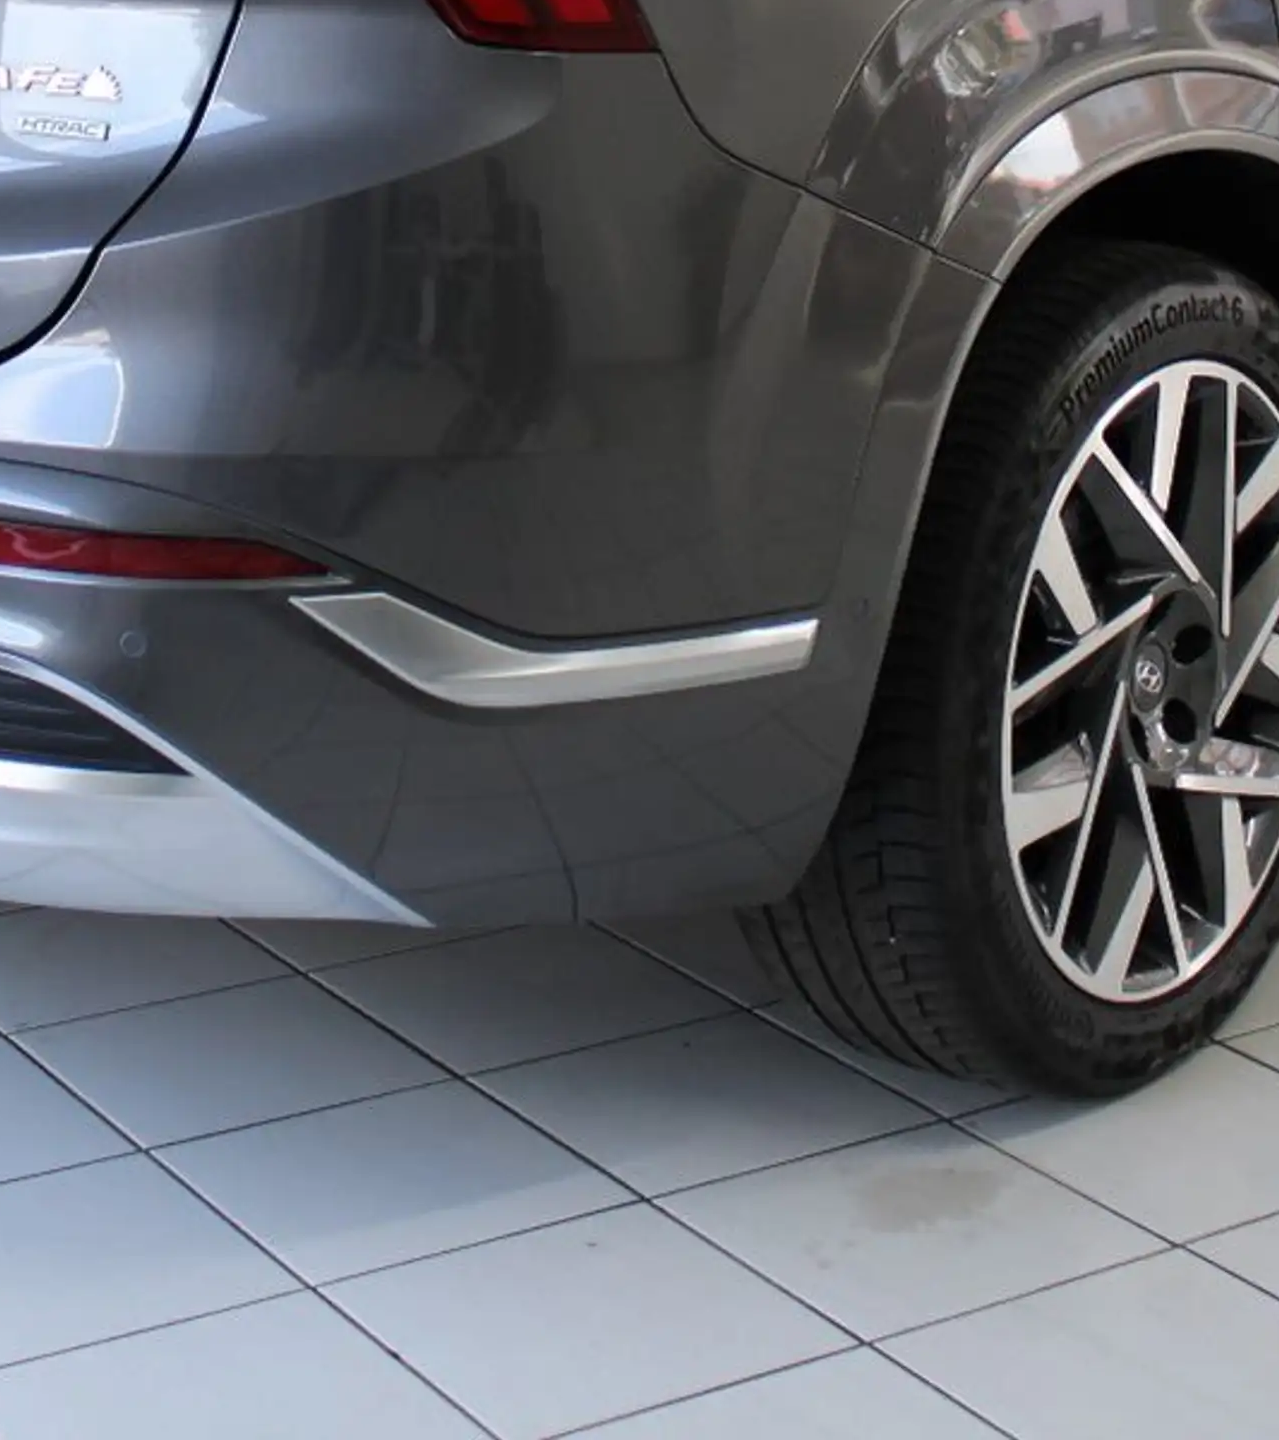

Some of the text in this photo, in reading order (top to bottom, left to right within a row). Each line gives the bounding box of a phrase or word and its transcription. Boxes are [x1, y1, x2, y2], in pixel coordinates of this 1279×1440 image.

[21, 118, 100, 138] HTRAC
[1058, 292, 1246, 426] PremiumContact 6
